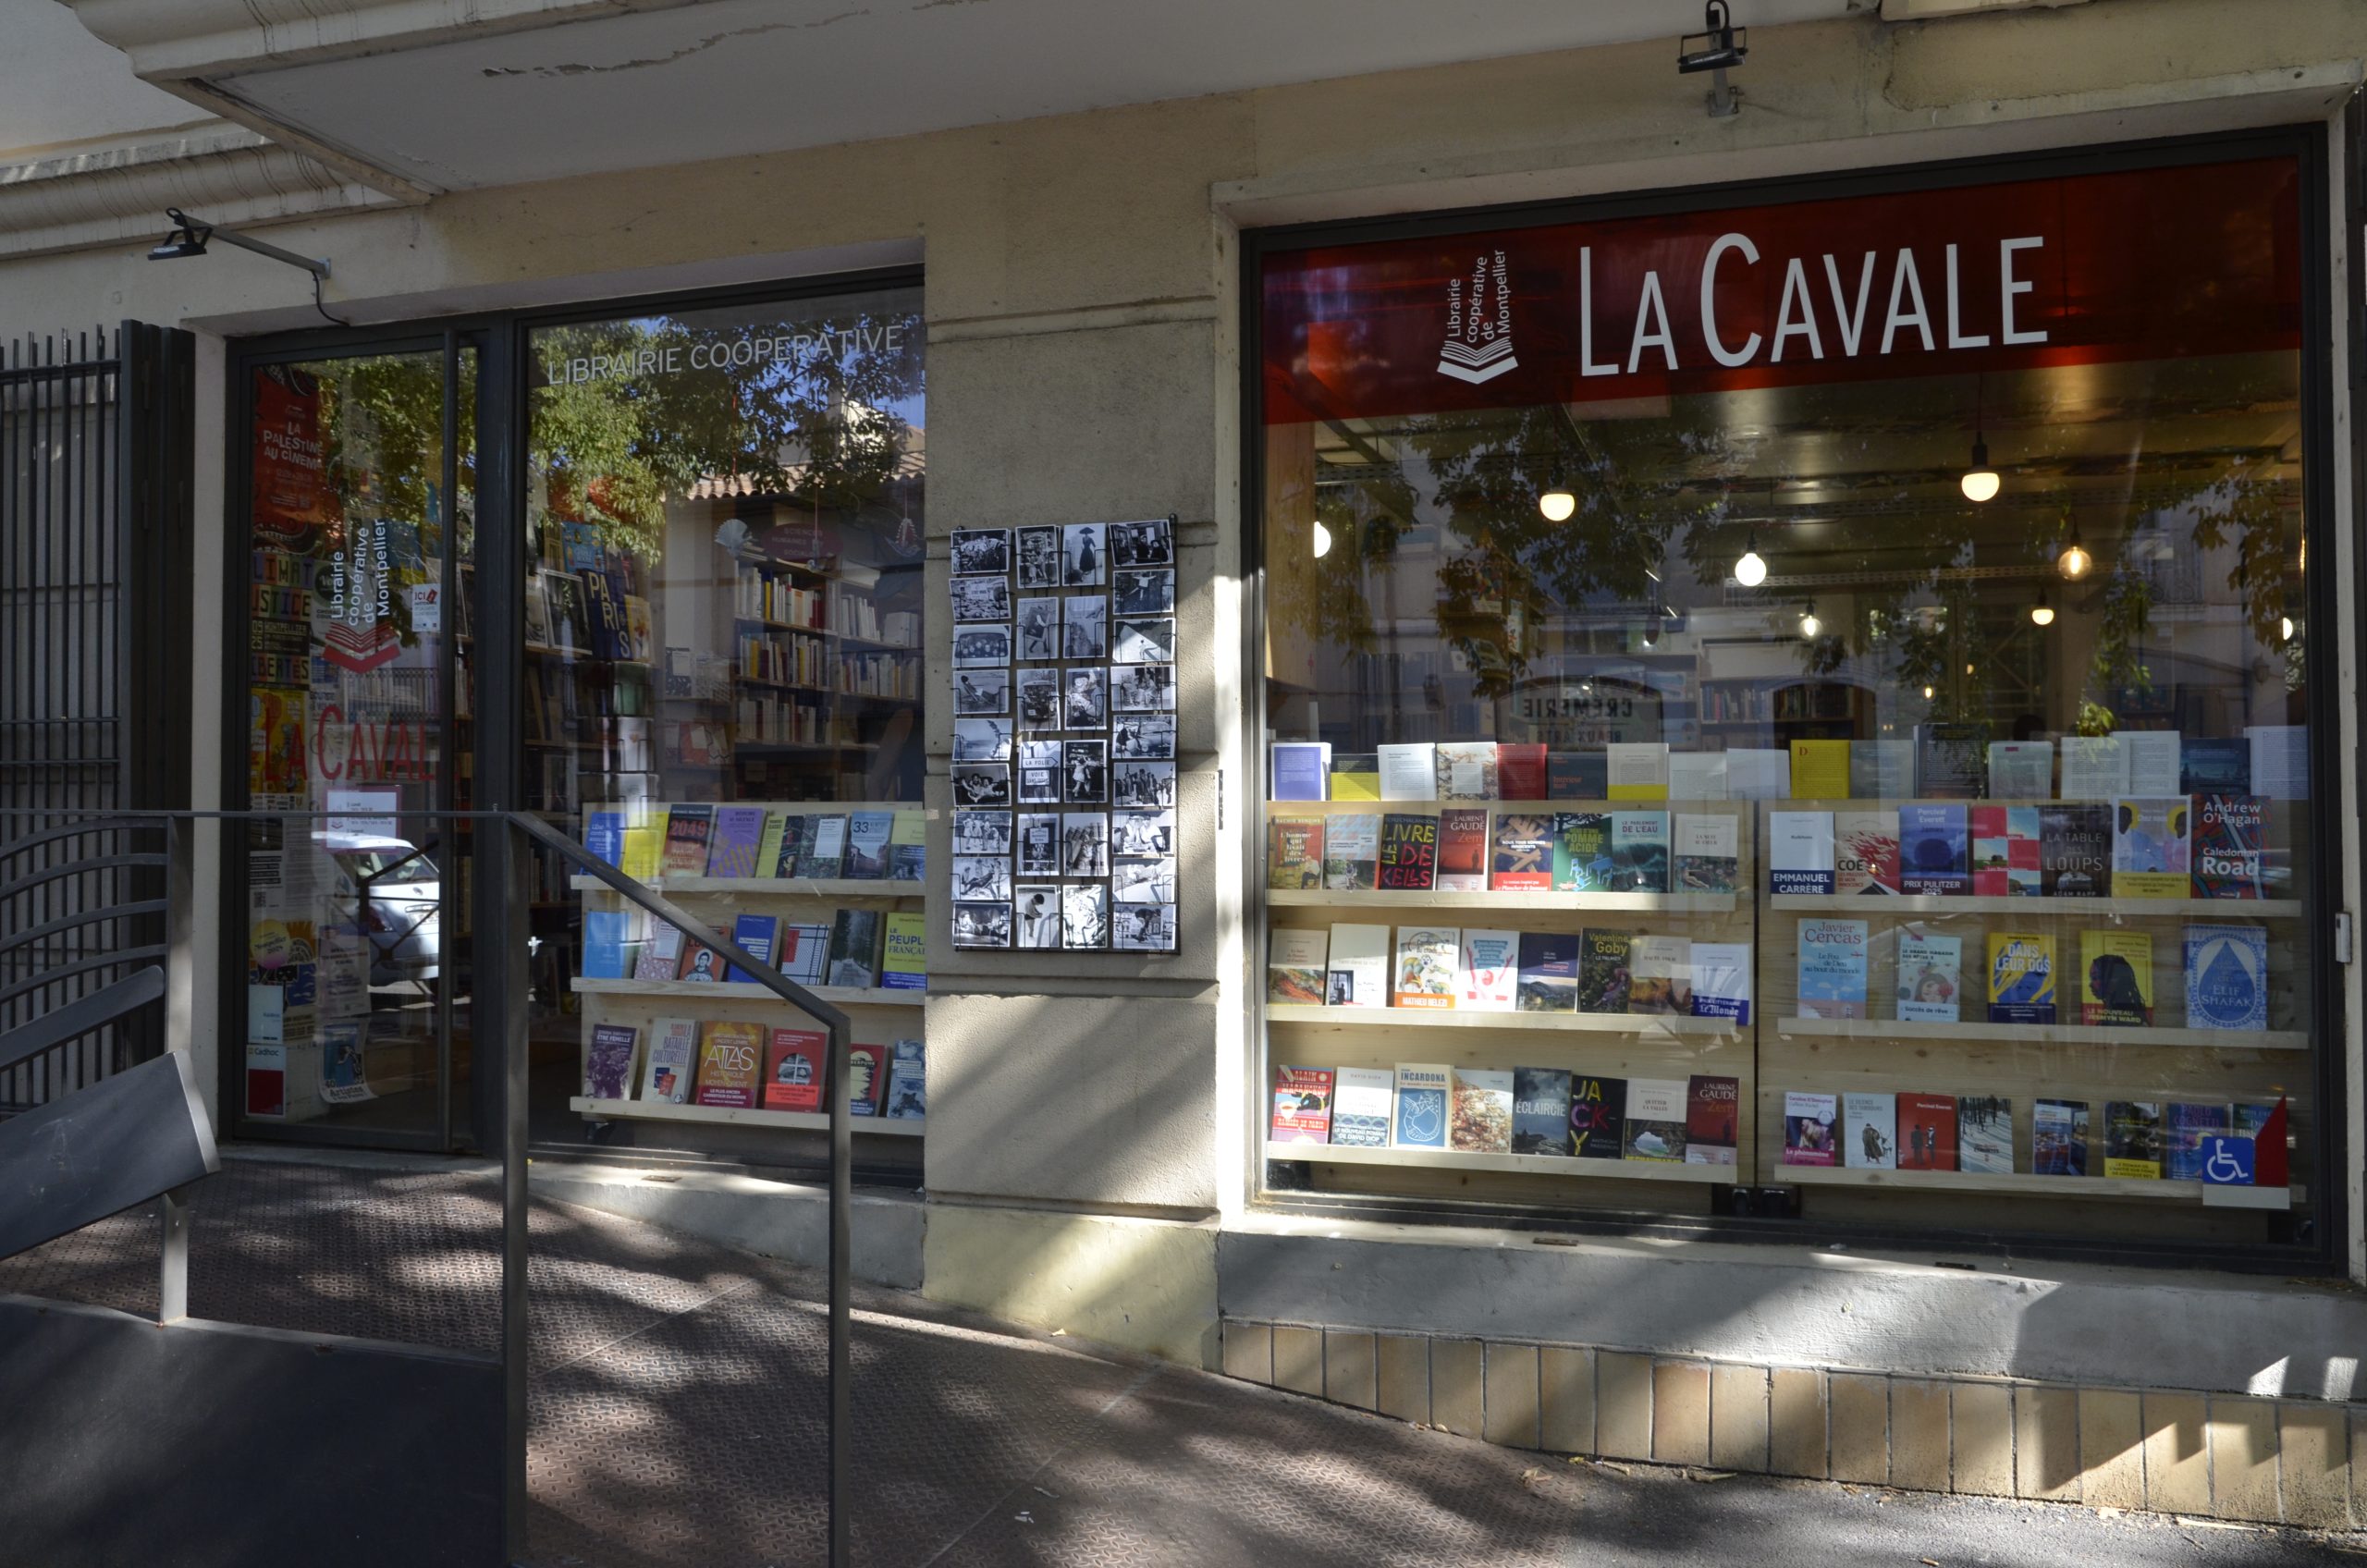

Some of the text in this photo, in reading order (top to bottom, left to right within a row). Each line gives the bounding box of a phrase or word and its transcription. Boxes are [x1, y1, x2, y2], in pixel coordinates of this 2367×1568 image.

[1492, 250, 1512, 333] Montpellier
[1467, 256, 1488, 343] coopérative
[1580, 233, 2048, 377] LA CAVALE
[1447, 278, 1461, 337] Librairie
[1480, 322, 1495, 340] de
[548, 348, 682, 385] LIBRAIRIE
[287, 422, 300, 435] LA
[264, 430, 323, 456] PALESTINE
[264, 447, 278, 460] AU
[377, 519, 390, 617] Montpellier
[349, 527, 370, 626] coopérative
[331, 551, 344, 619] Librairie
[365, 602, 377, 623] de
[318, 705, 437, 780] CAVAL
[2203, 802, 2261, 813] Andrew
[853, 821, 869, 833] 33
[1451, 822, 1485, 830] GAUDÉ
[2203, 813, 2261, 827] O'Hagan
[669, 820, 707, 837] 2049
[1383, 824, 1435, 843] LIVRE
[1458, 833, 1482, 843] Zem
[1564, 833, 1603, 844] POMME
[2046, 833, 2102, 843] LA TABLE
[1569, 842, 1598, 853] ACIDE
[2203, 847, 2259, 857] Caledonian
[1401, 843, 1433, 867] DE
[1838, 860, 1863, 871] COE
[2046, 857, 2103, 871] LOUPS
[2202, 856, 2259, 876] Road
[1382, 868, 1432, 888] KELLS
[1772, 873, 1830, 883] EMMANUEL
[1779, 883, 1824, 894] CARRÈRE
[1819, 922, 1855, 933] Javier
[889, 936, 925, 945] PEUPL
[1589, 933, 1628, 942] Valentine
[1805, 928, 1861, 944] Cercas
[888, 946, 925, 956] FRANÇAI
[1596, 941, 1628, 956] Goby
[2007, 944, 2039, 958] DANS
[1995, 957, 2051, 973] LEUR DOS
[2213, 985, 2241, 996] ELIF
[2201, 995, 2250, 1007] SHAFAK
[1709, 1004, 1739, 1016] Monde
[1905, 1005, 1924, 1013] Succès
[663, 1036, 689, 1050] BATAILLE
[653, 1049, 687, 1063] CULTURELLE
[704, 1045, 754, 1072] ATLAS
[1401, 1072, 1445, 1082] INCARDONA
[1699, 1089, 1736, 1100] GAUDÉ
[1515, 1098, 1566, 1117] ÉCLAIRCIE
[1708, 1101, 1735, 1113] Zem
